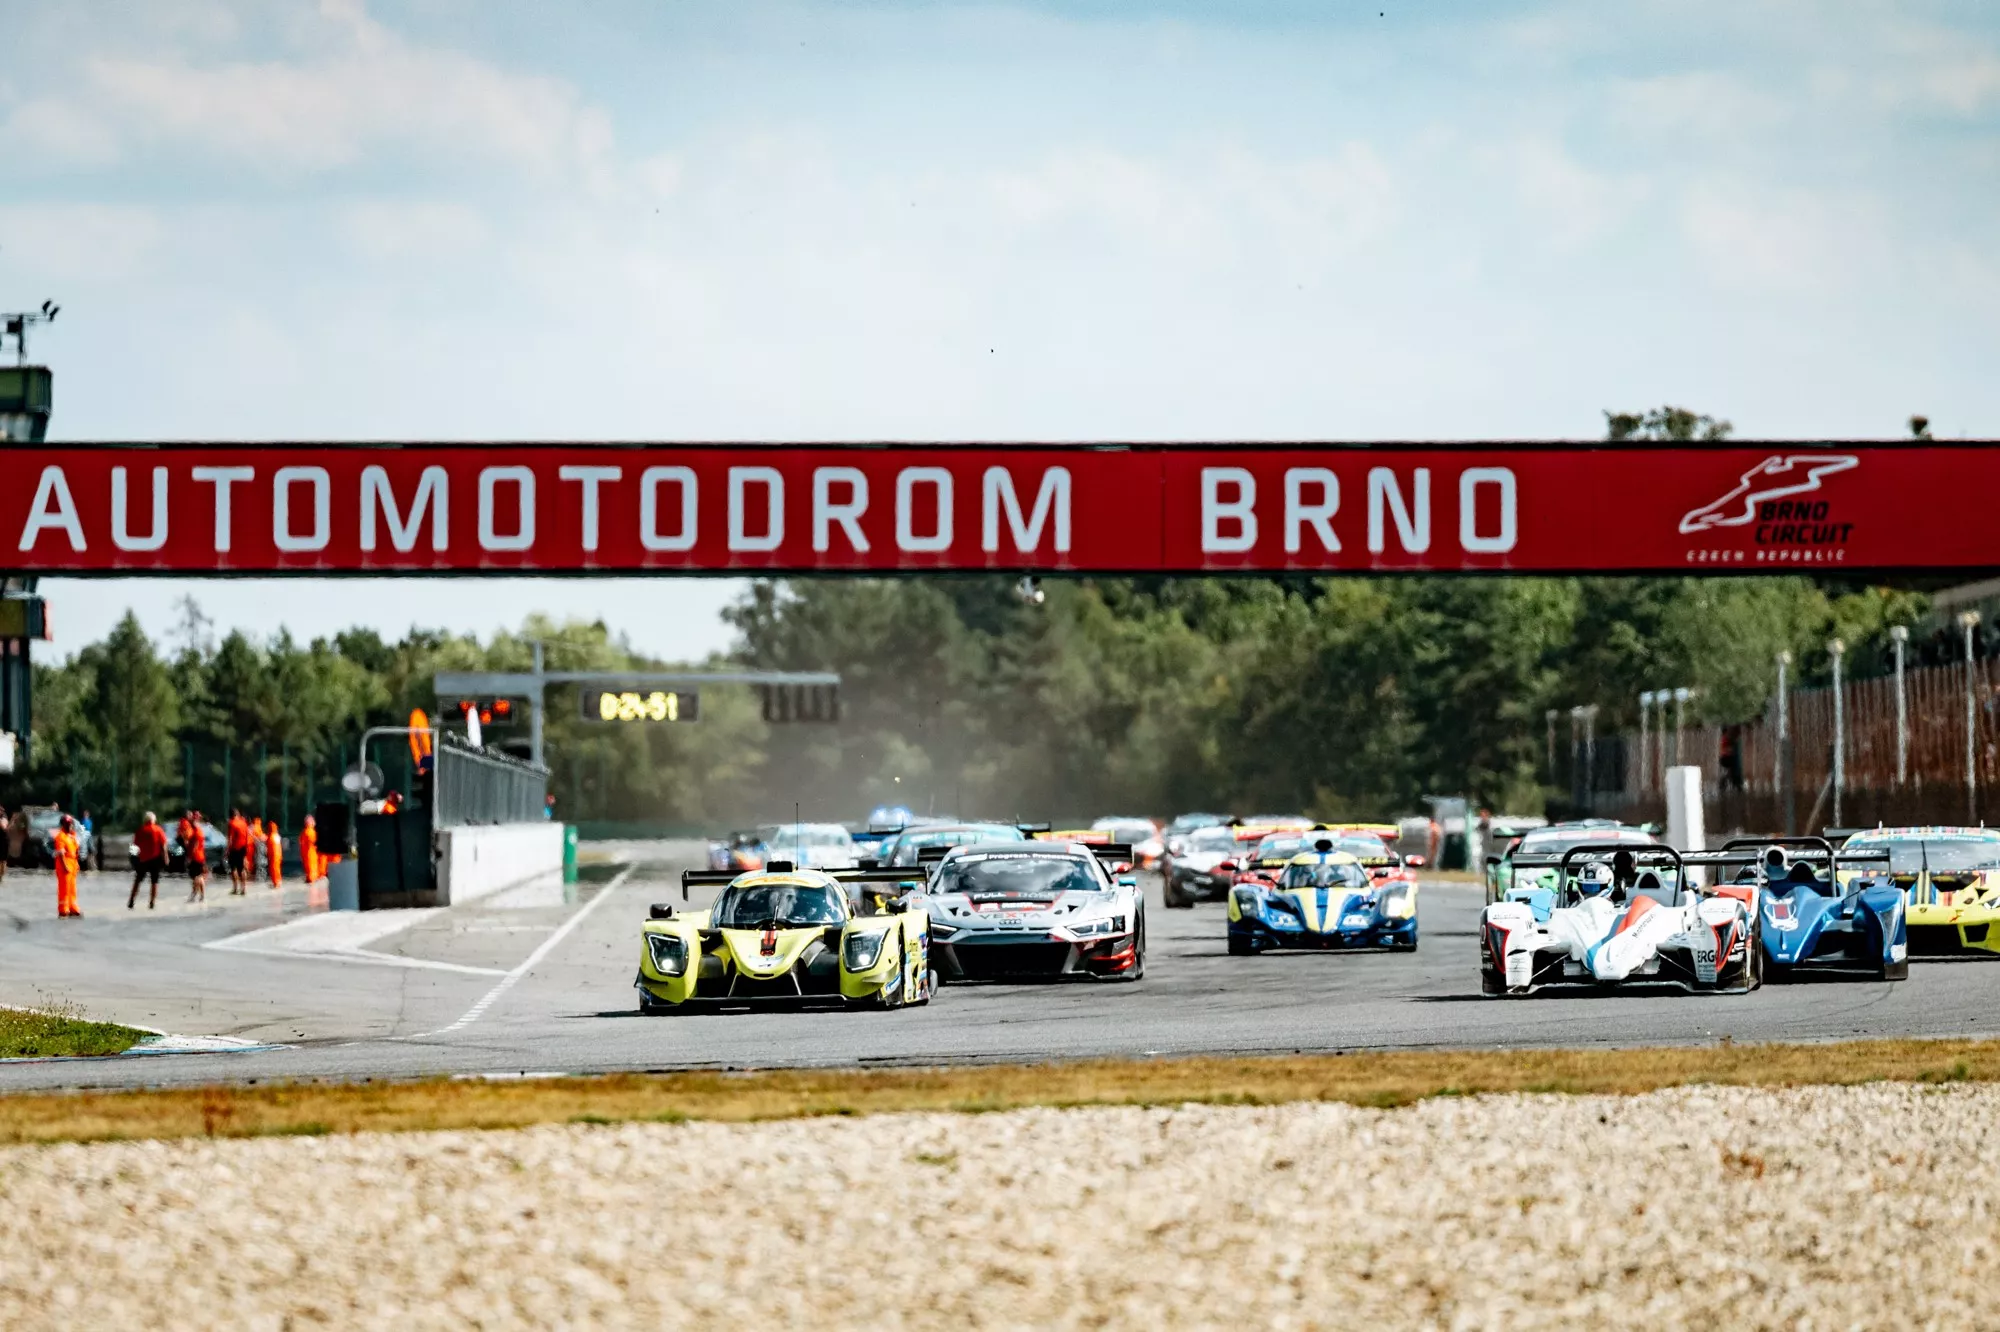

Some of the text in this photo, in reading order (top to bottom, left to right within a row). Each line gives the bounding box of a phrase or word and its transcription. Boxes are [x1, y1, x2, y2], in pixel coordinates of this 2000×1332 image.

[19, 466, 1516, 552] AUTOMOTODROM BRNO
[1760, 501, 1829, 521] BRNO
[1755, 523, 1854, 544] CIRCUIT
[1686, 550, 1846, 562] CZECH REPUBLIC
